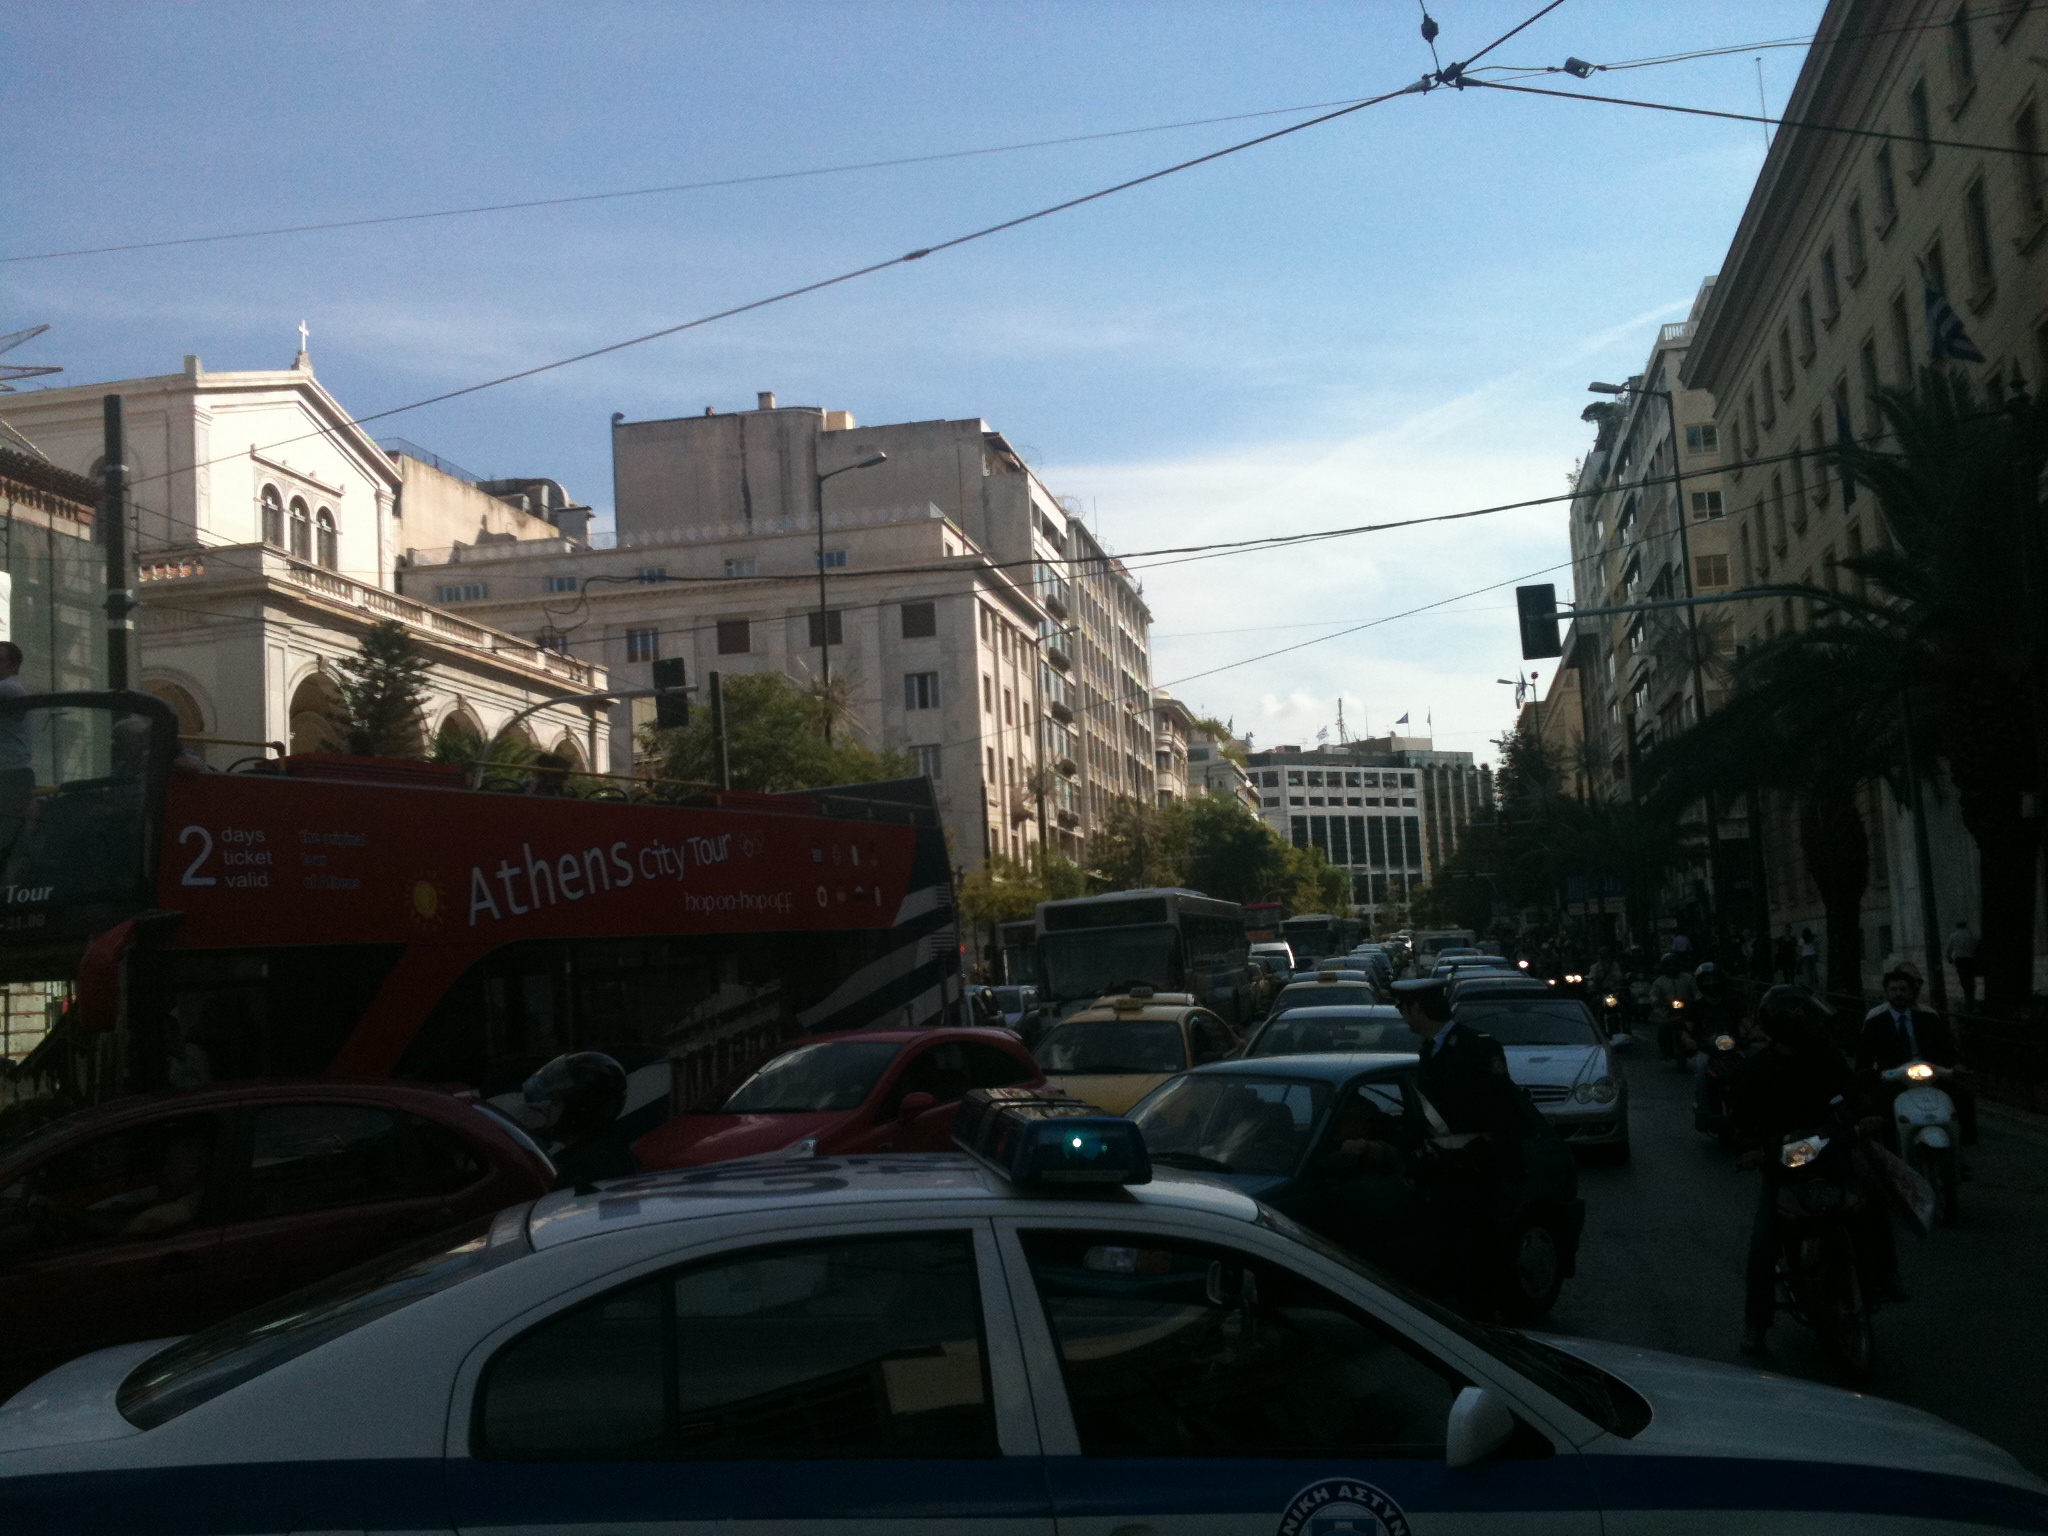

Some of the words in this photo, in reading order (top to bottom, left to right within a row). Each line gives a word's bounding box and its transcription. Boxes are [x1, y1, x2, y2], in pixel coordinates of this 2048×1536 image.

[221, 826, 266, 847] days
[178, 825, 217, 886] 2
[223, 850, 273, 866] ticket
[225, 872, 270, 888] valid
[468, 841, 635, 927] Athens
[638, 839, 686, 882] city
[687, 833, 731, 867] Tour
[6, 884, 55, 904] Tour
[1282, 1486, 1331, 1536] ΝΙΚΗ
[1337, 1484, 1407, 1536] ΑΣΤΥΝ
